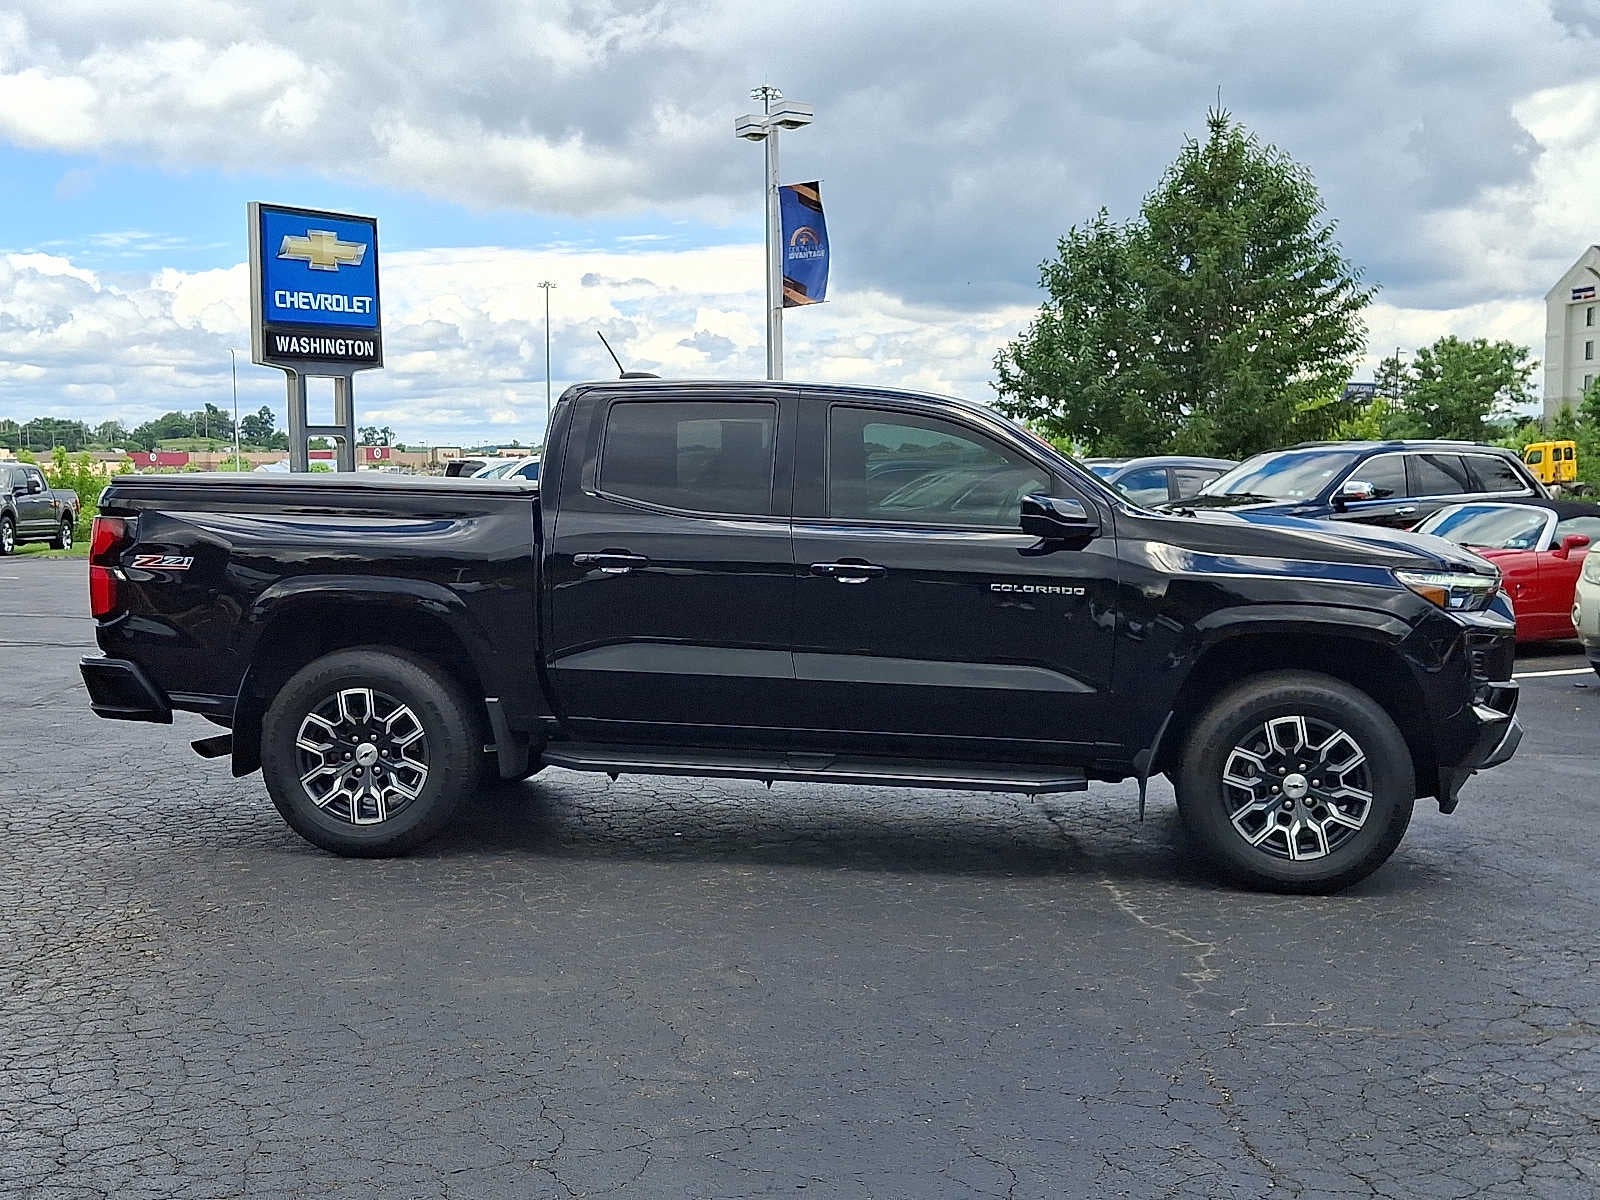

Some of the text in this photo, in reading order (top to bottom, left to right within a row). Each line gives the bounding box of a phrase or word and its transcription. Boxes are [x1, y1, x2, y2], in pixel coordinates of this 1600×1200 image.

[274, 290, 372, 314] CHEVROLET
[275, 335, 374, 357] WASHINGTON
[131, 554, 194, 570] Z71
[990, 583, 1085, 596] COLORADO
